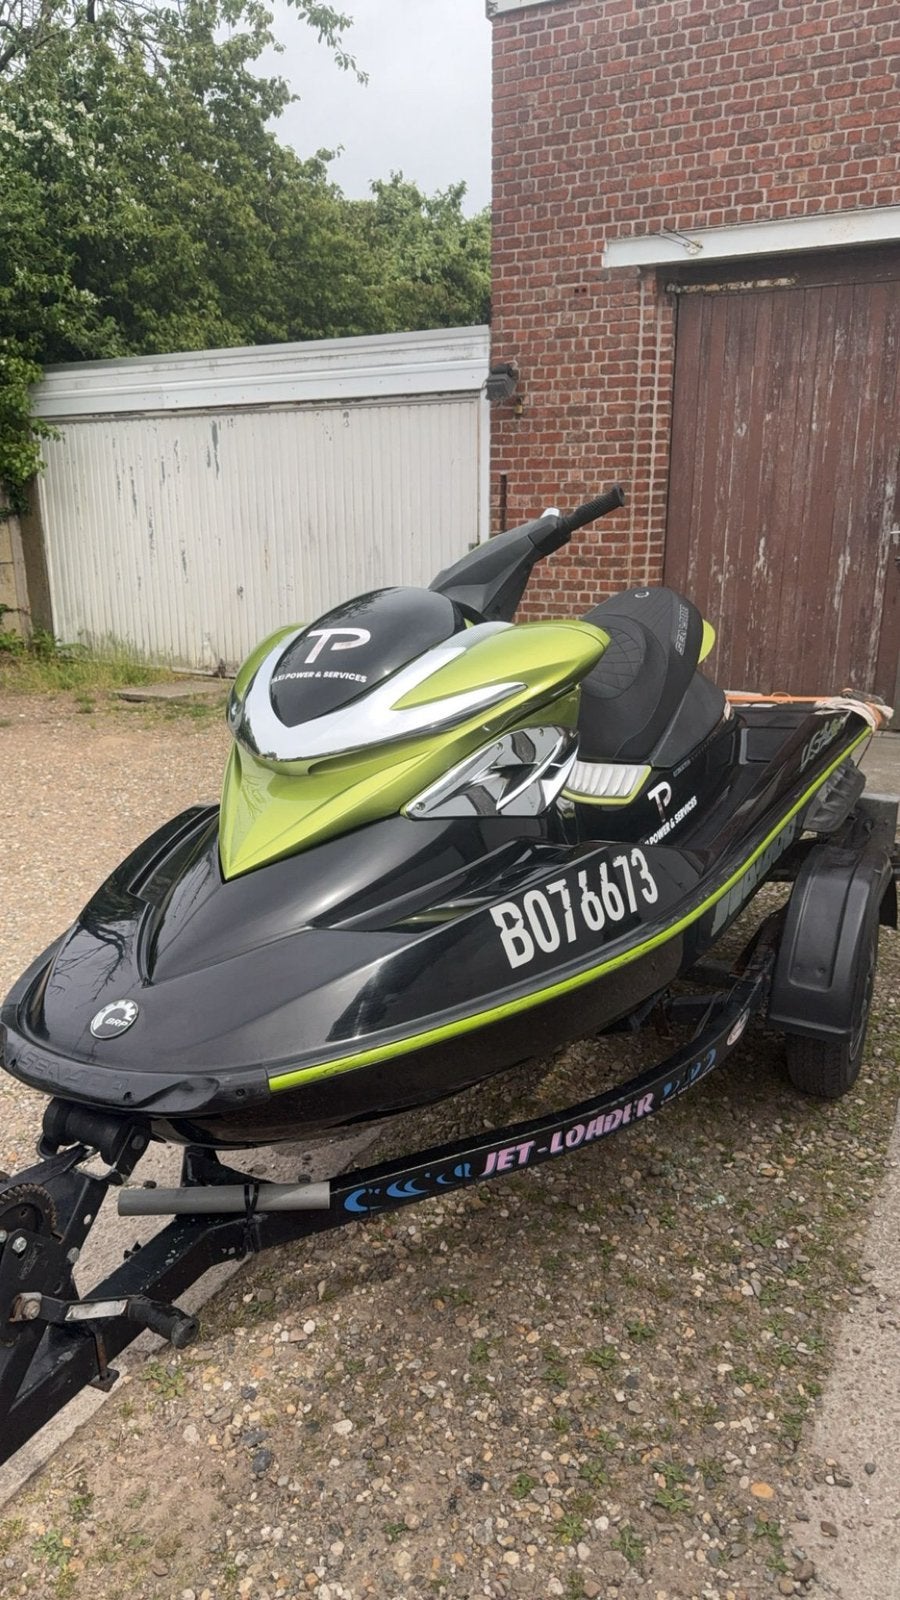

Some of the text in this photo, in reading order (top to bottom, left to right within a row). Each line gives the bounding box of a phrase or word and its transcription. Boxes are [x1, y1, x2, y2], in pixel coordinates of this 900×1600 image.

[285, 671, 314, 680] POWER
[323, 671, 368, 683] SERVICES
[649, 795, 698, 845] POWER & SERVICES
[104, 1017, 129, 1027] BRP
